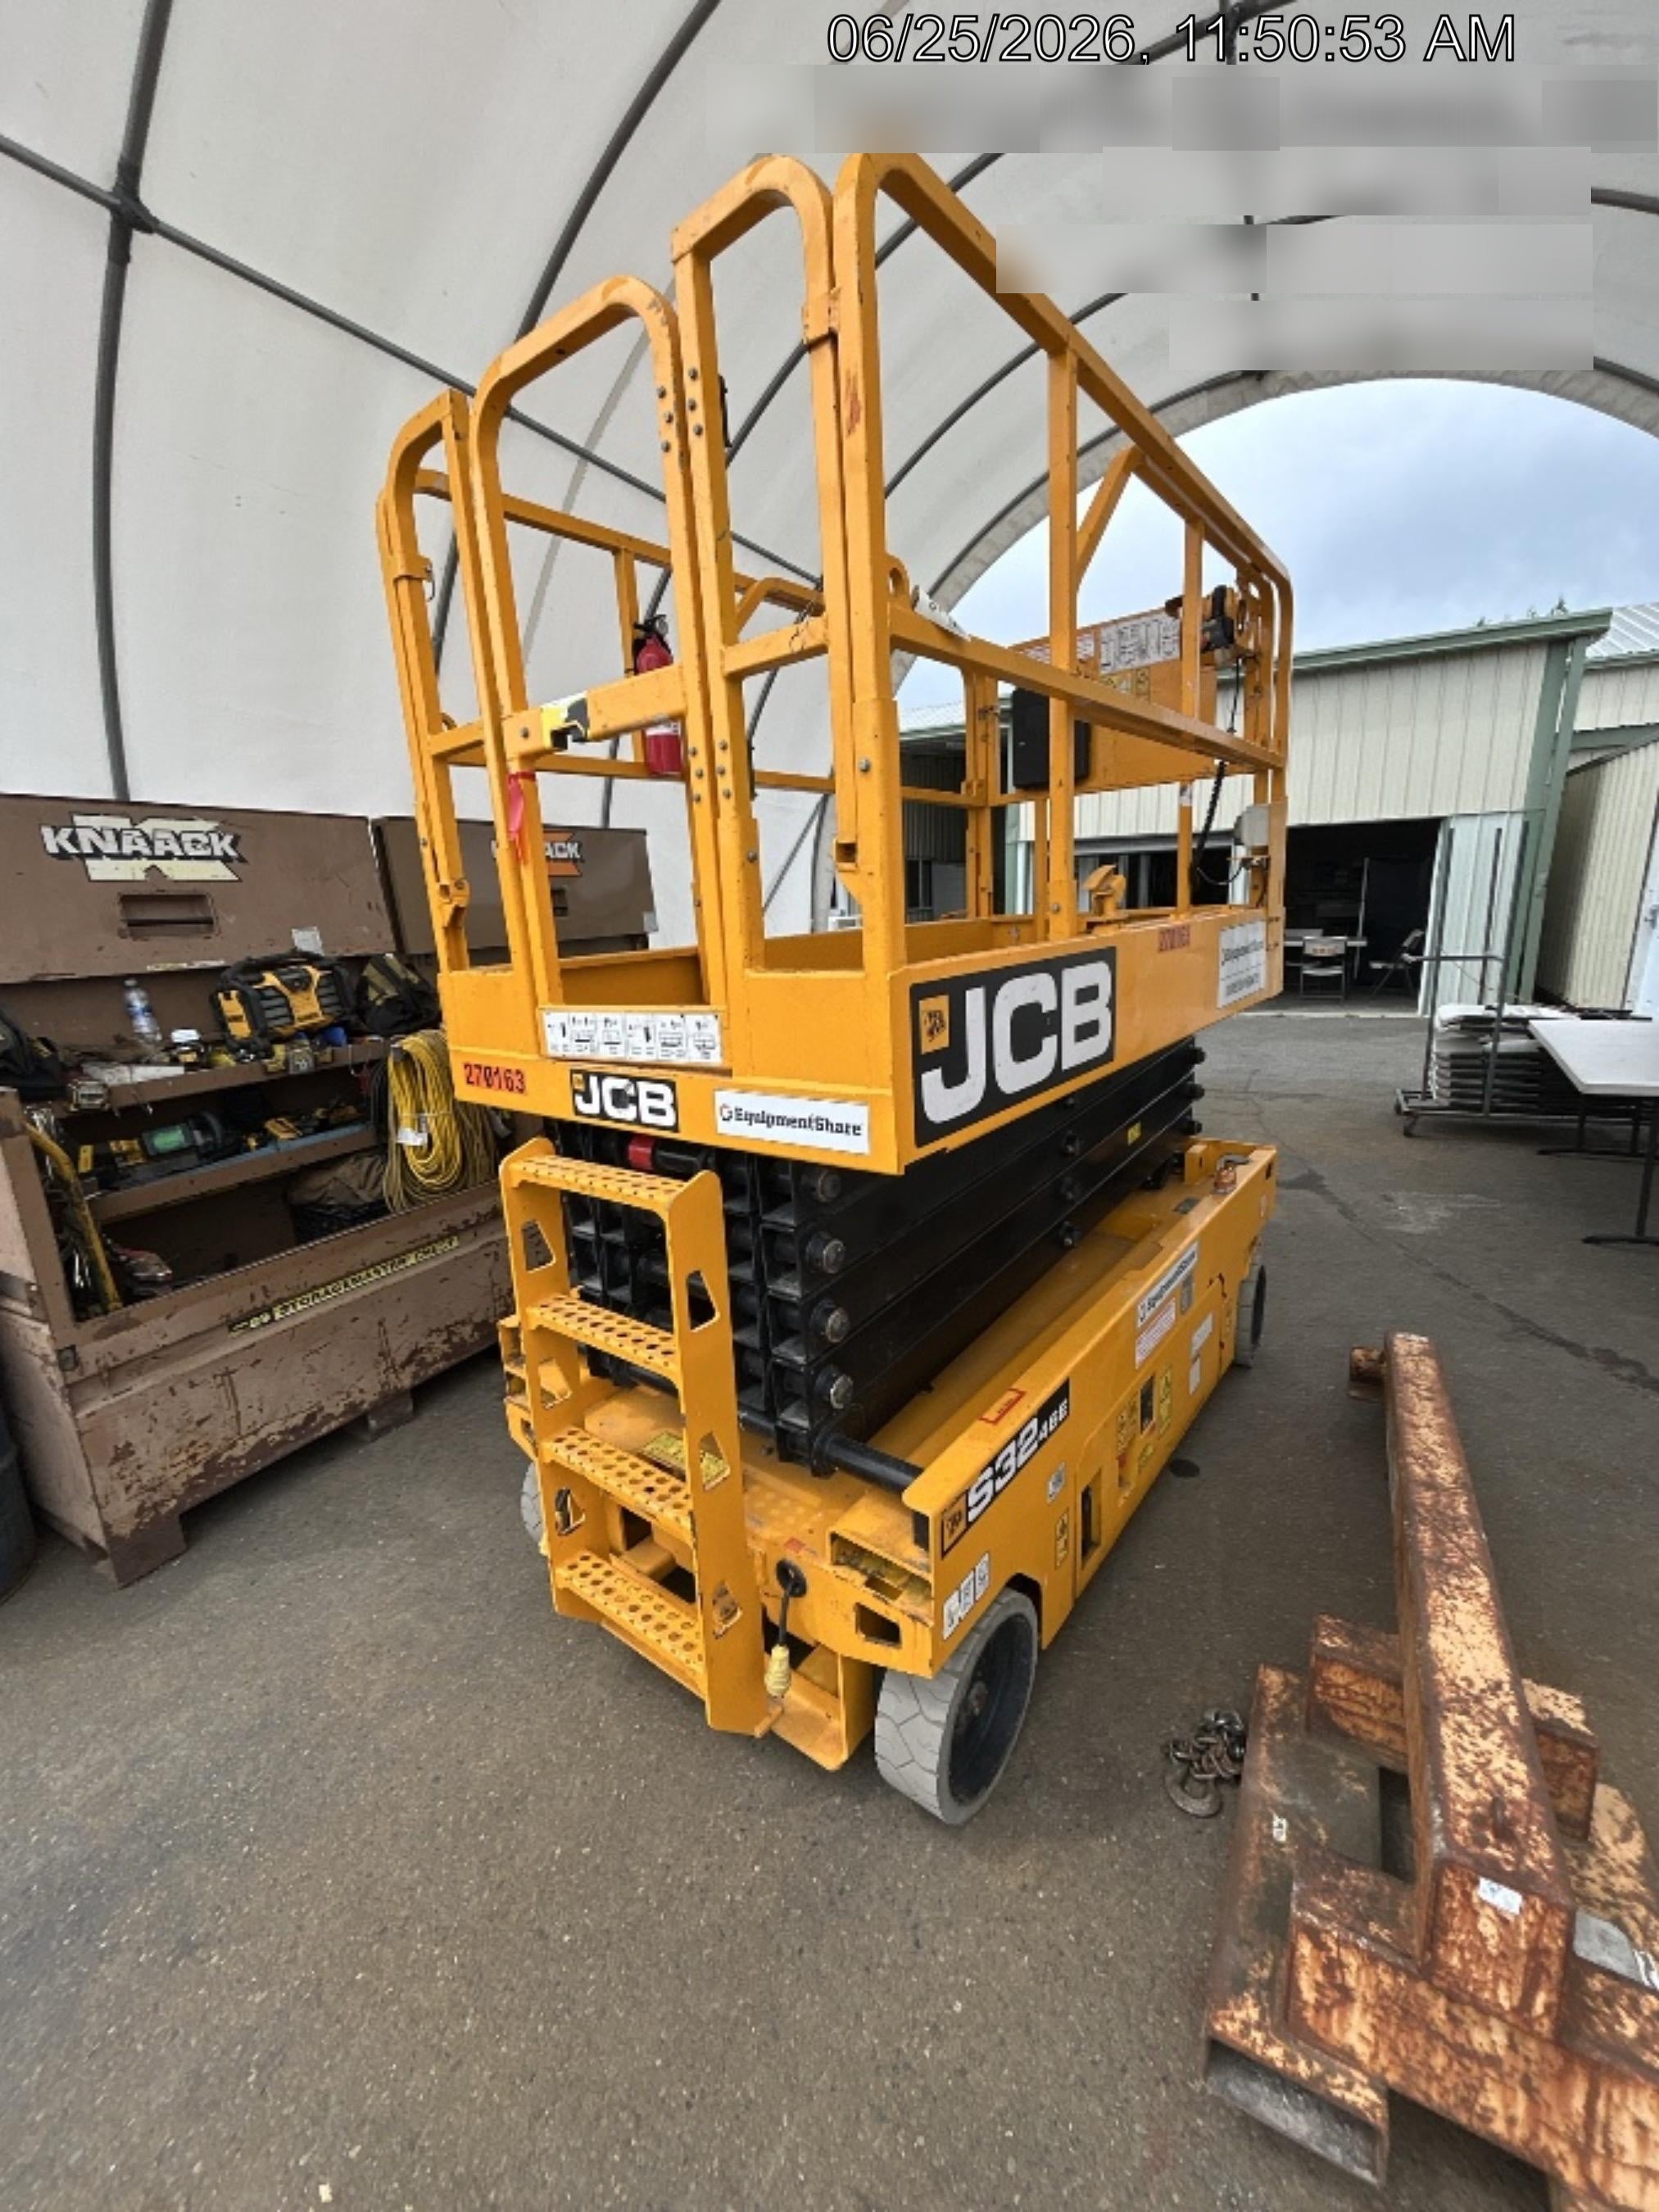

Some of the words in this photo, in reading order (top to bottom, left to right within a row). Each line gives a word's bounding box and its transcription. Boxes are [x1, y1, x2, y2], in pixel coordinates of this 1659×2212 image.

[41, 825, 239, 859] KNAACK
[921, 961, 1113, 1124] JCB
[464, 1063, 527, 1095] 270163
[574, 1074, 678, 1128] JCB
[734, 1107, 863, 1137] EquipmentShare
